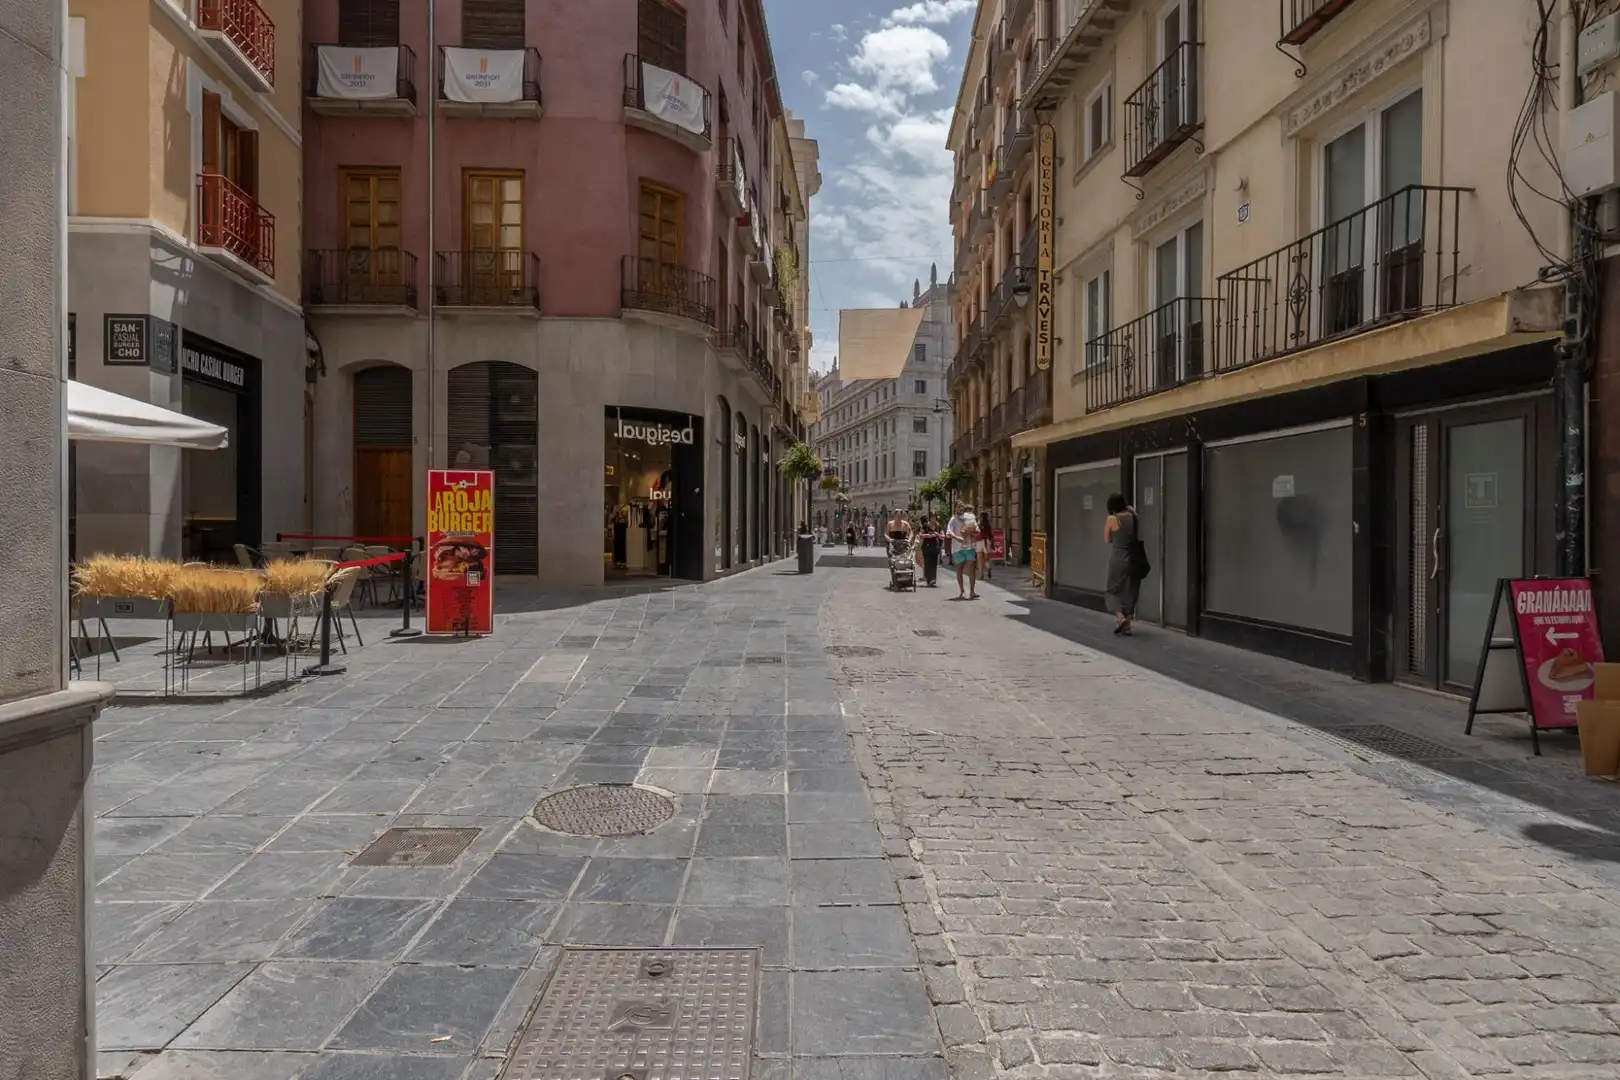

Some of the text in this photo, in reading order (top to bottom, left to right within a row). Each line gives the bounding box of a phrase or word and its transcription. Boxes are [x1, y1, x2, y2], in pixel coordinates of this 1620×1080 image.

[1040, 155, 1052, 258] GESTORIA
[1039, 269, 1050, 357] TRAVESI
[113, 332, 139, 342] CASUAL
[200, 353, 223, 380] CASUAL
[222, 361, 244, 386] BURGER
[1359, 412, 1368, 427] 5
[428, 510, 492, 533] BURGER
